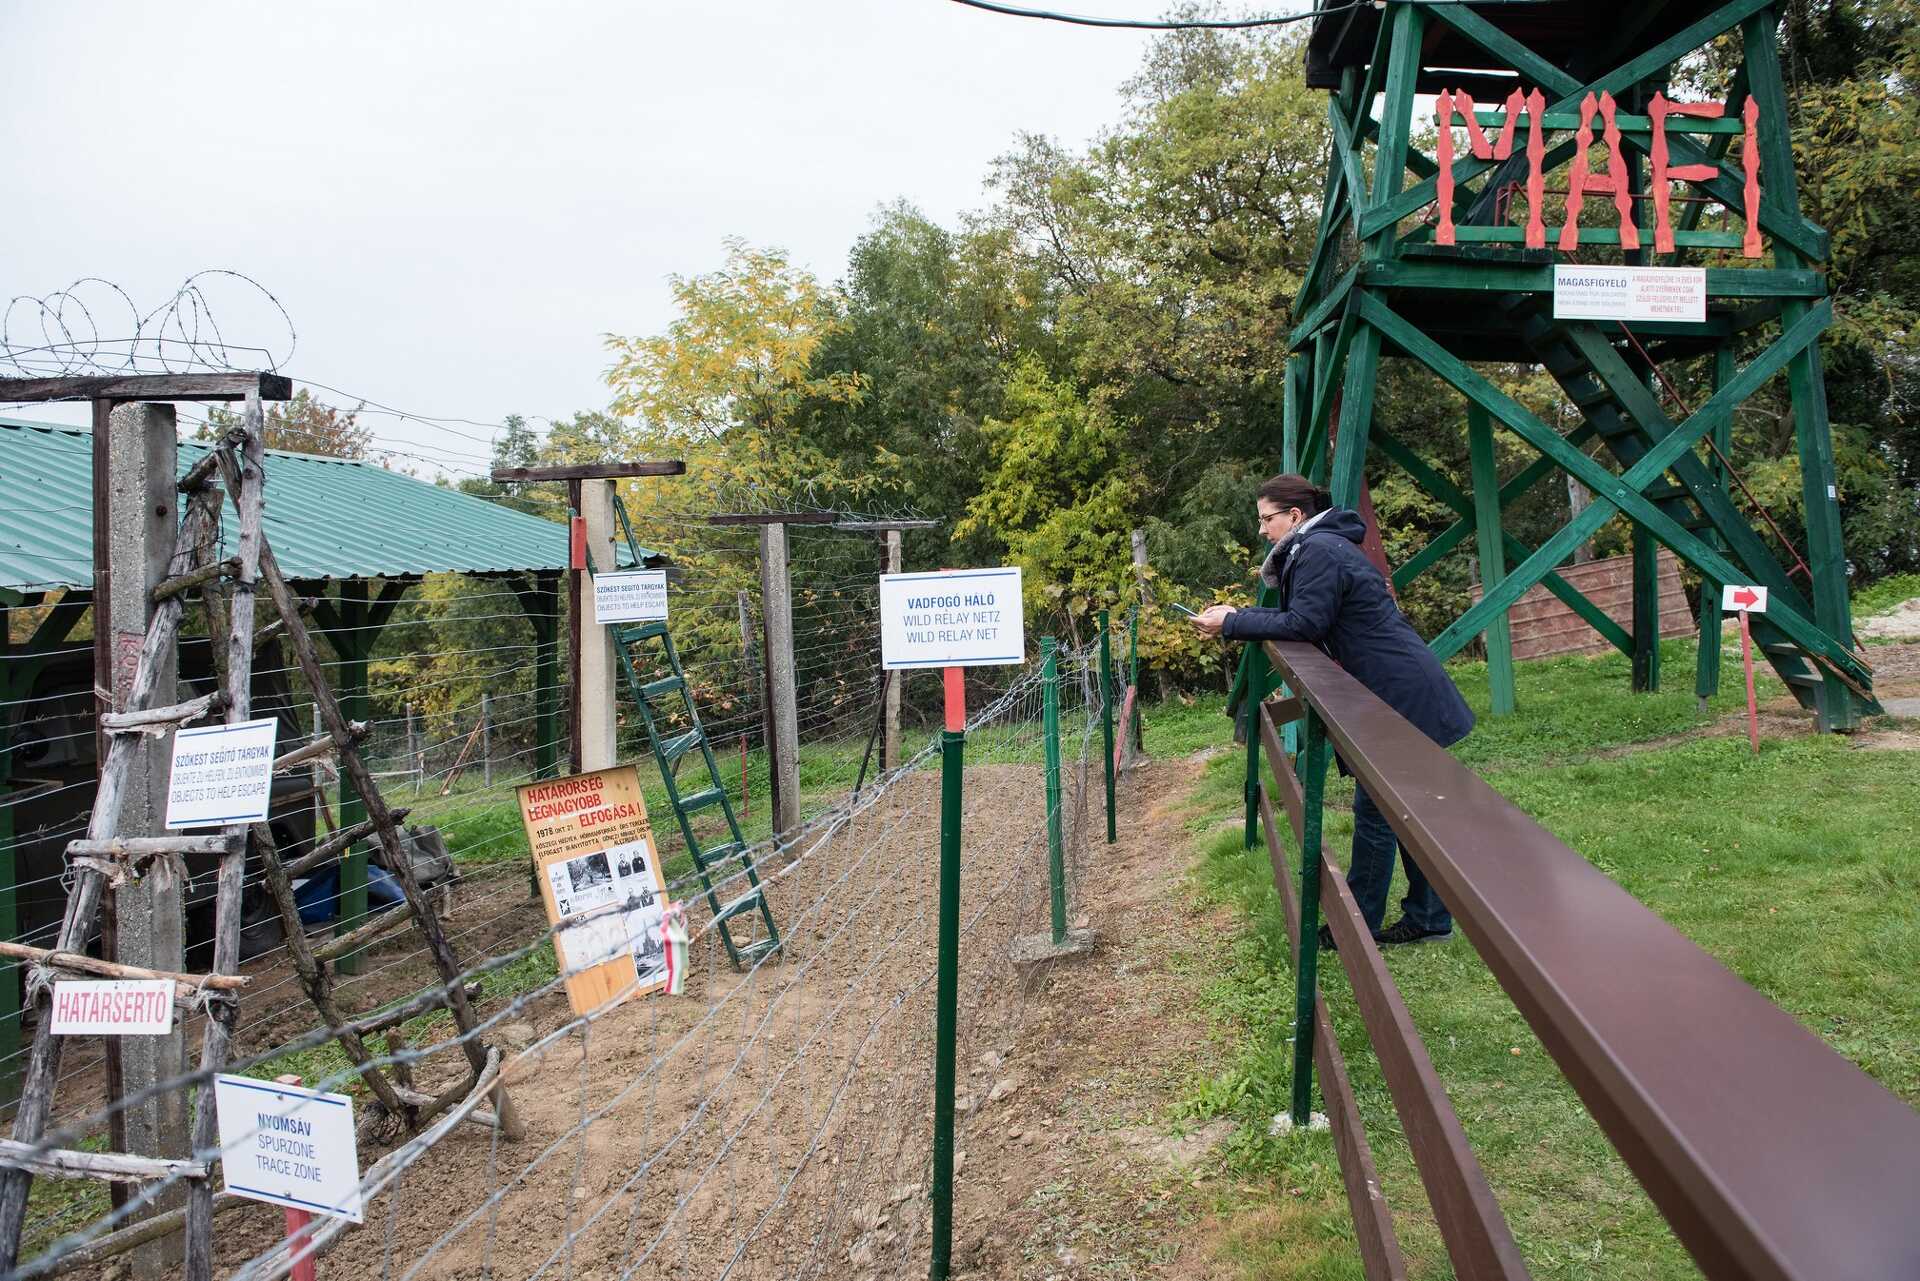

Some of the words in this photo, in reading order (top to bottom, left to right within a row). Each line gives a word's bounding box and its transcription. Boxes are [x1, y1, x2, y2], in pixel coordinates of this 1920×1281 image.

[907, 593, 961, 609] VADFOGÓ
[964, 591, 995, 606] HÁLÓ
[903, 614, 932, 627] WILD
[935, 612, 970, 625] RELAY
[973, 610, 1001, 623] NETZ
[906, 631, 935, 643] WILD
[938, 629, 974, 642] RELAY
[976, 628, 999, 640] NET
[527, 793, 602, 822] LEGNAGYOBB
[257, 1112, 312, 1137] NYOMSÁV
[258, 1134, 316, 1160] SPURZONE
[256, 1154, 292, 1176] TRACE
[294, 1163, 323, 1183] ZONE
